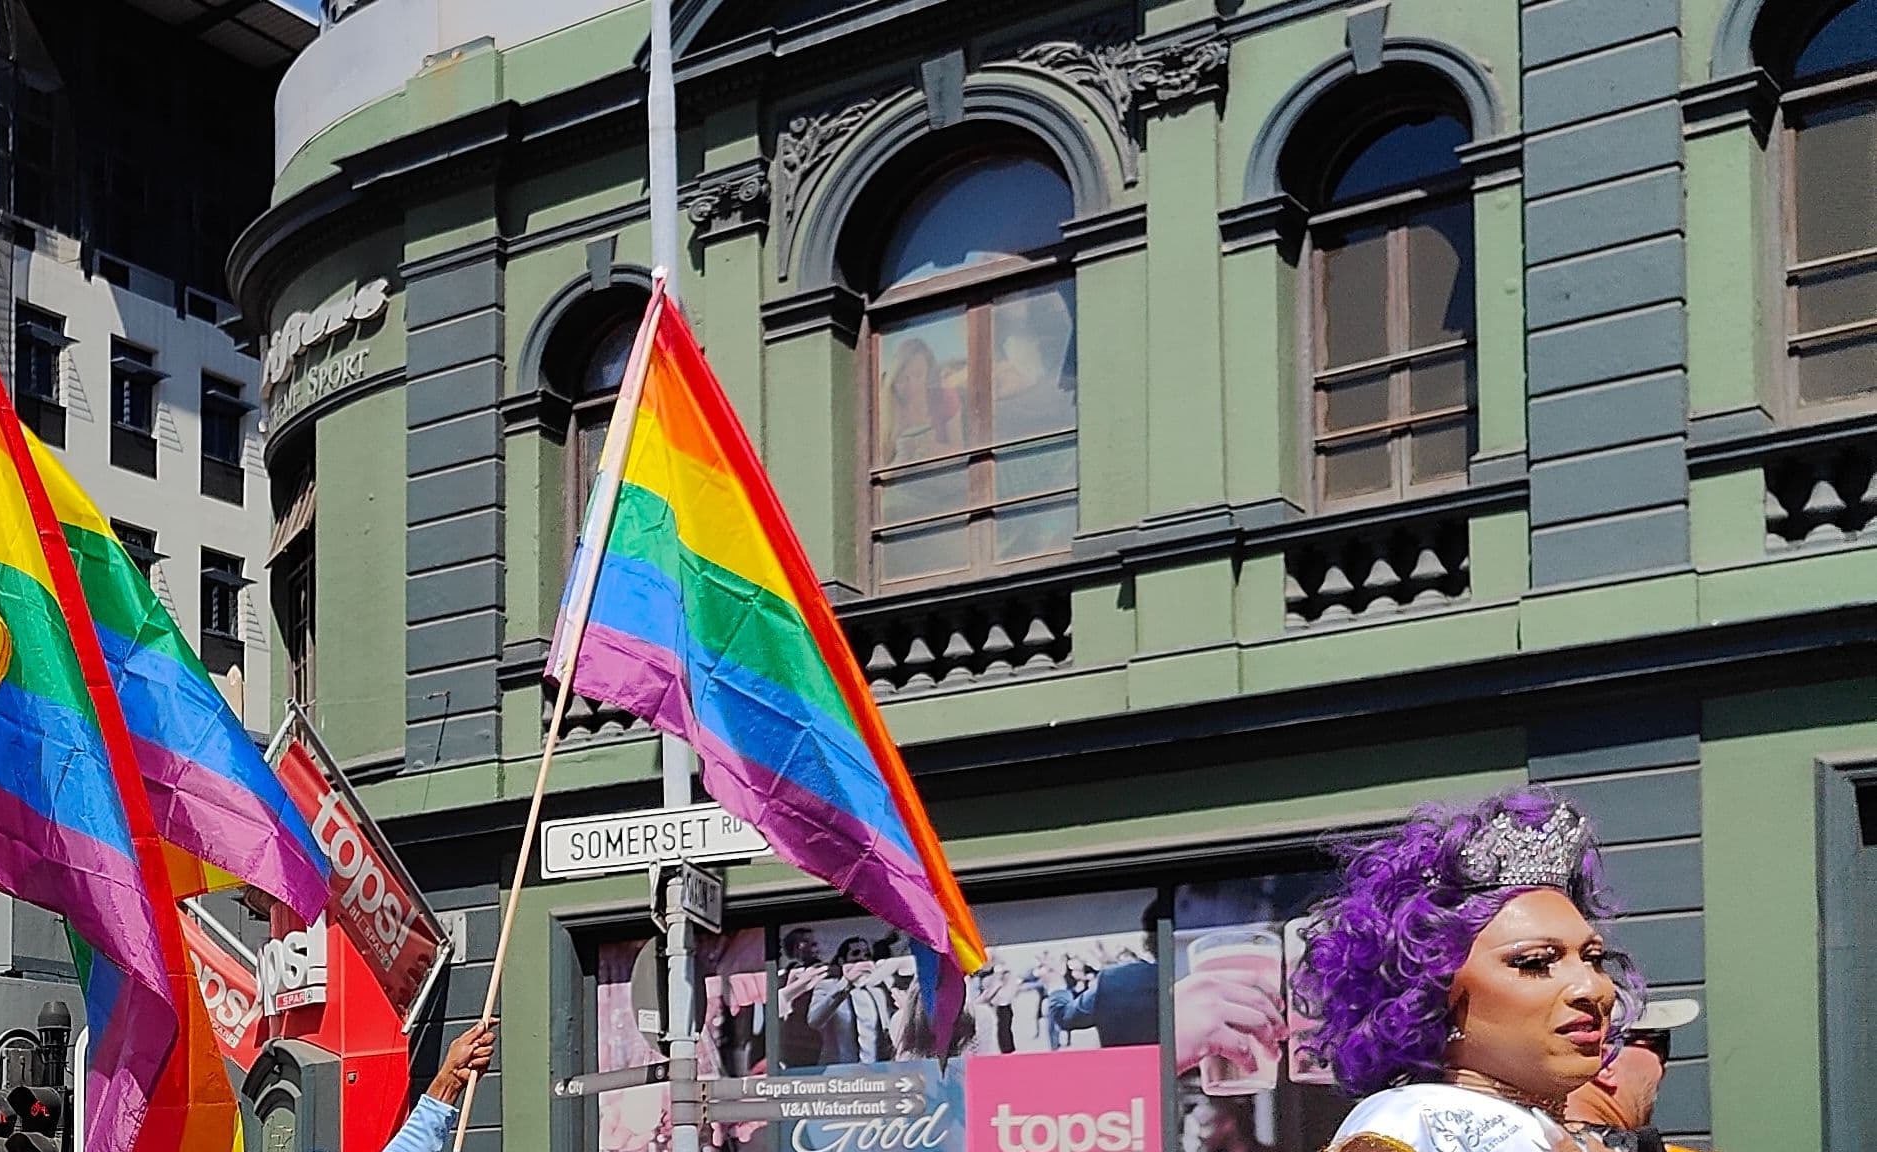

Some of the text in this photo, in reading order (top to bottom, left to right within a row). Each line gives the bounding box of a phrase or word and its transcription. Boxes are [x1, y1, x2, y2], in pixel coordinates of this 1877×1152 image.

[307, 348, 370, 398] SPORT
[570, 815, 744, 861] SOMERSET RD
[311, 791, 418, 961] tops!
[282, 992, 307, 1006] SPAR
[567, 1081, 584, 1096] City
[755, 1077, 886, 1097] Cape Town Stadium
[780, 1100, 886, 1118] V&A Waterfront
